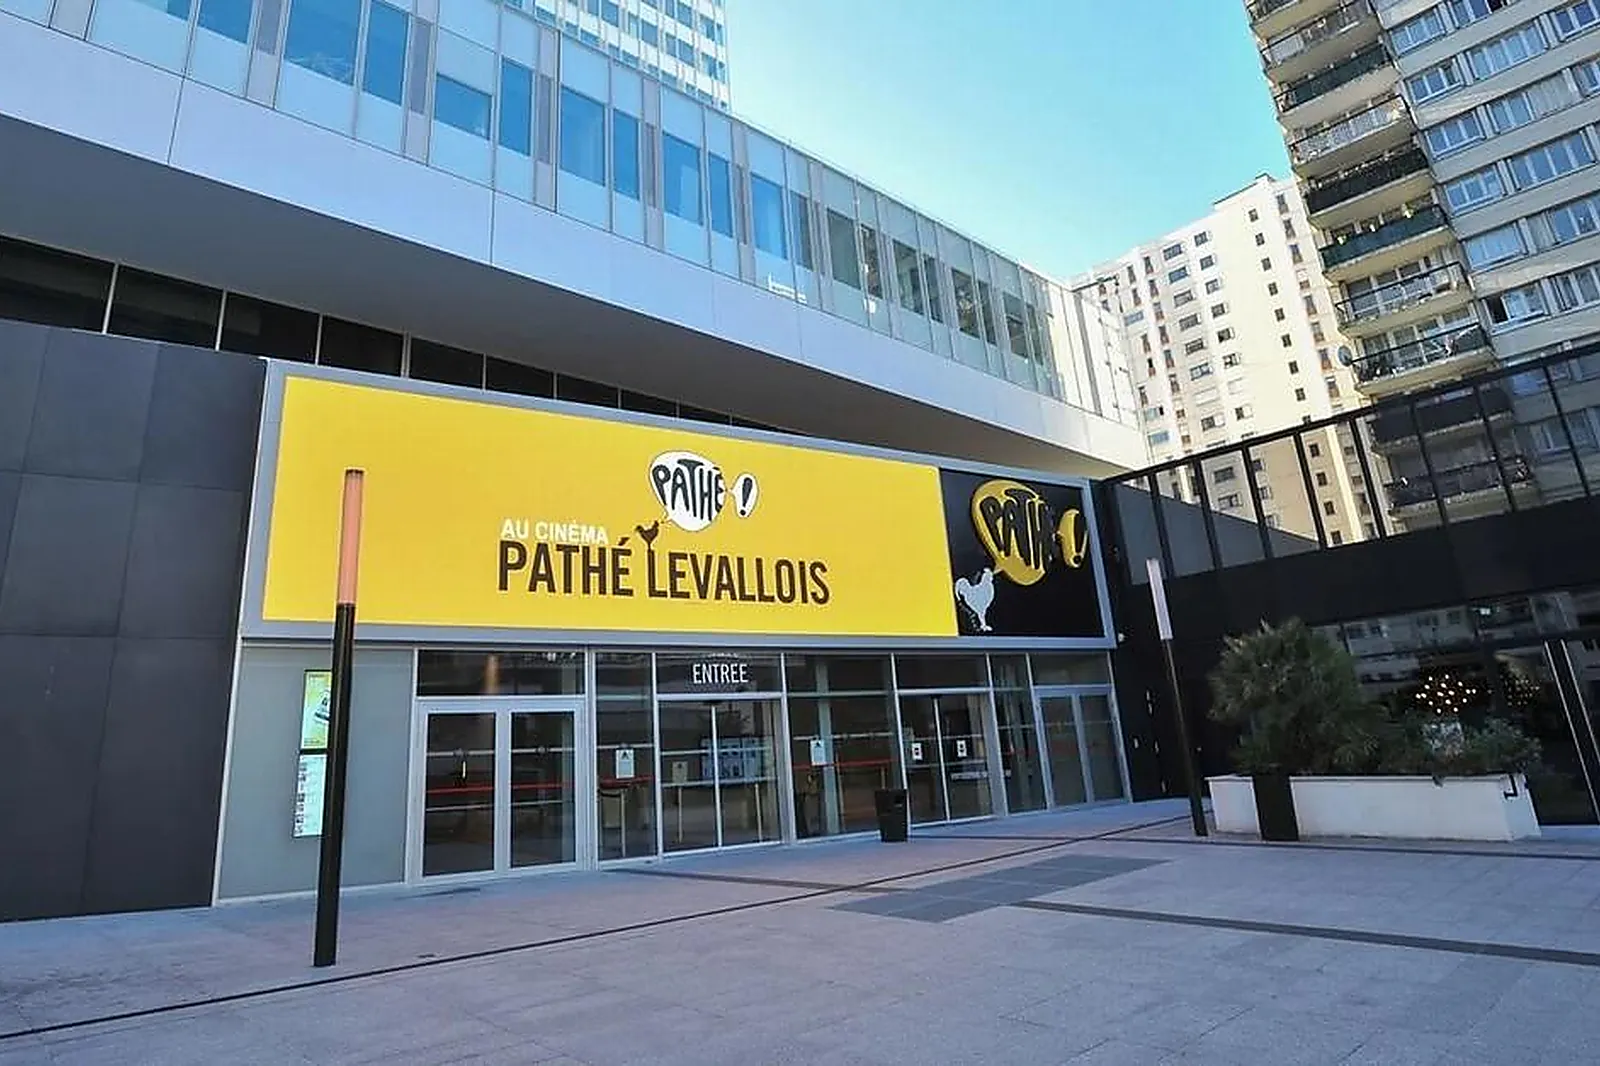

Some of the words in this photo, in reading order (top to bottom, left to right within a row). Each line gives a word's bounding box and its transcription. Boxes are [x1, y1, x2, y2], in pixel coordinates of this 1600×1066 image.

[501, 520, 530, 540] AU
[536, 519, 609, 545] CINÉMA
[499, 537, 634, 597] PATHÉ
[648, 549, 831, 605] LEVALLOIS
[692, 663, 749, 684] ENTREE
